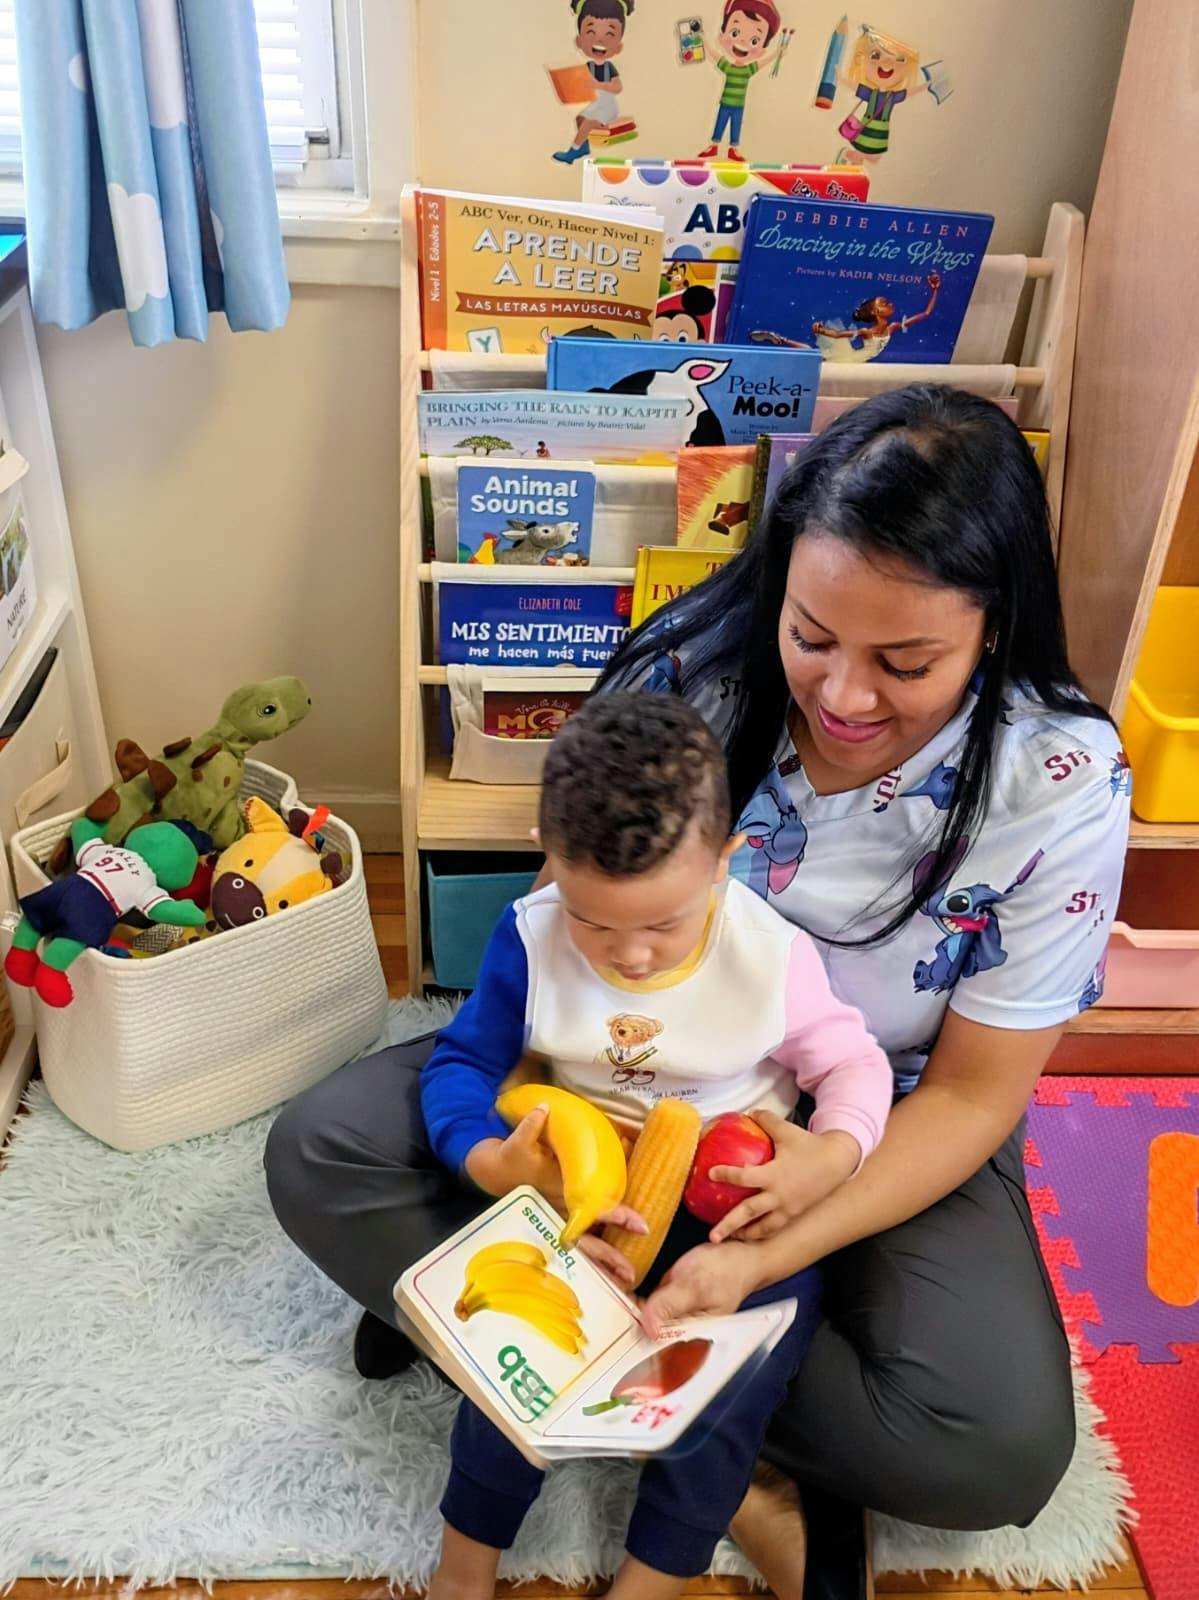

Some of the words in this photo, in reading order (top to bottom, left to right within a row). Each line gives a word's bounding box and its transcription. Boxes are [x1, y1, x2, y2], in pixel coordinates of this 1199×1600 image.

[428, 201, 440, 221] 2-5
[683, 203, 749, 234] AB
[461, 204, 493, 219] ABC
[498, 210, 523, 225] Ver,
[528, 212, 553, 229] Oír,
[558, 219, 599, 235] Hacer
[602, 226, 638, 242] Nivel
[643, 235, 655, 246] 1:
[776, 209, 869, 229] DEBBIE
[889, 219, 969, 238] ALLEN
[429, 223, 440, 261] Edades
[473, 227, 642, 272] APRENDE
[755, 224, 844, 260] Dancing
[846, 238, 865, 257] in
[869, 240, 901, 260] the
[907, 240, 974, 270] Wings
[494, 261, 521, 286] A
[534, 263, 620, 295] LEER
[796, 267, 825, 276] Pictures
[839, 269, 873, 281] KADIR
[877, 273, 922, 284] NELSON
[430, 277, 440, 302] Nivel
[466, 300, 492, 310] LAS
[496, 301, 546, 313] LETRAS
[552, 302, 641, 320] MAYÚSCULAS
[727, 375, 812, 397] Peek-a-
[427, 401, 509, 413] BRINGING
[513, 401, 546, 413] THE
[550, 402, 591, 414] RAIN
[595, 405, 618, 417] TO
[623, 407, 678, 418] KAPITI
[732, 396, 800, 418] Moo!
[427, 416, 477, 427] PLAIN
[484, 475, 578, 498] Animal
[471, 494, 569, 516] Sounds
[651, 584, 691, 600] IM
[519, 597, 560, 610] ELIZABETH
[563, 598, 582, 610] COLE
[452, 622, 491, 641] MIS
[469, 646, 489, 657] me
[498, 644, 539, 658] hacen
[547, 645, 574, 660] más
[582, 648, 619, 662] fuer
[95, 857, 124, 873] 97
[105, 849, 140, 876] WALLY
[521, 1206, 576, 1270] bananas
